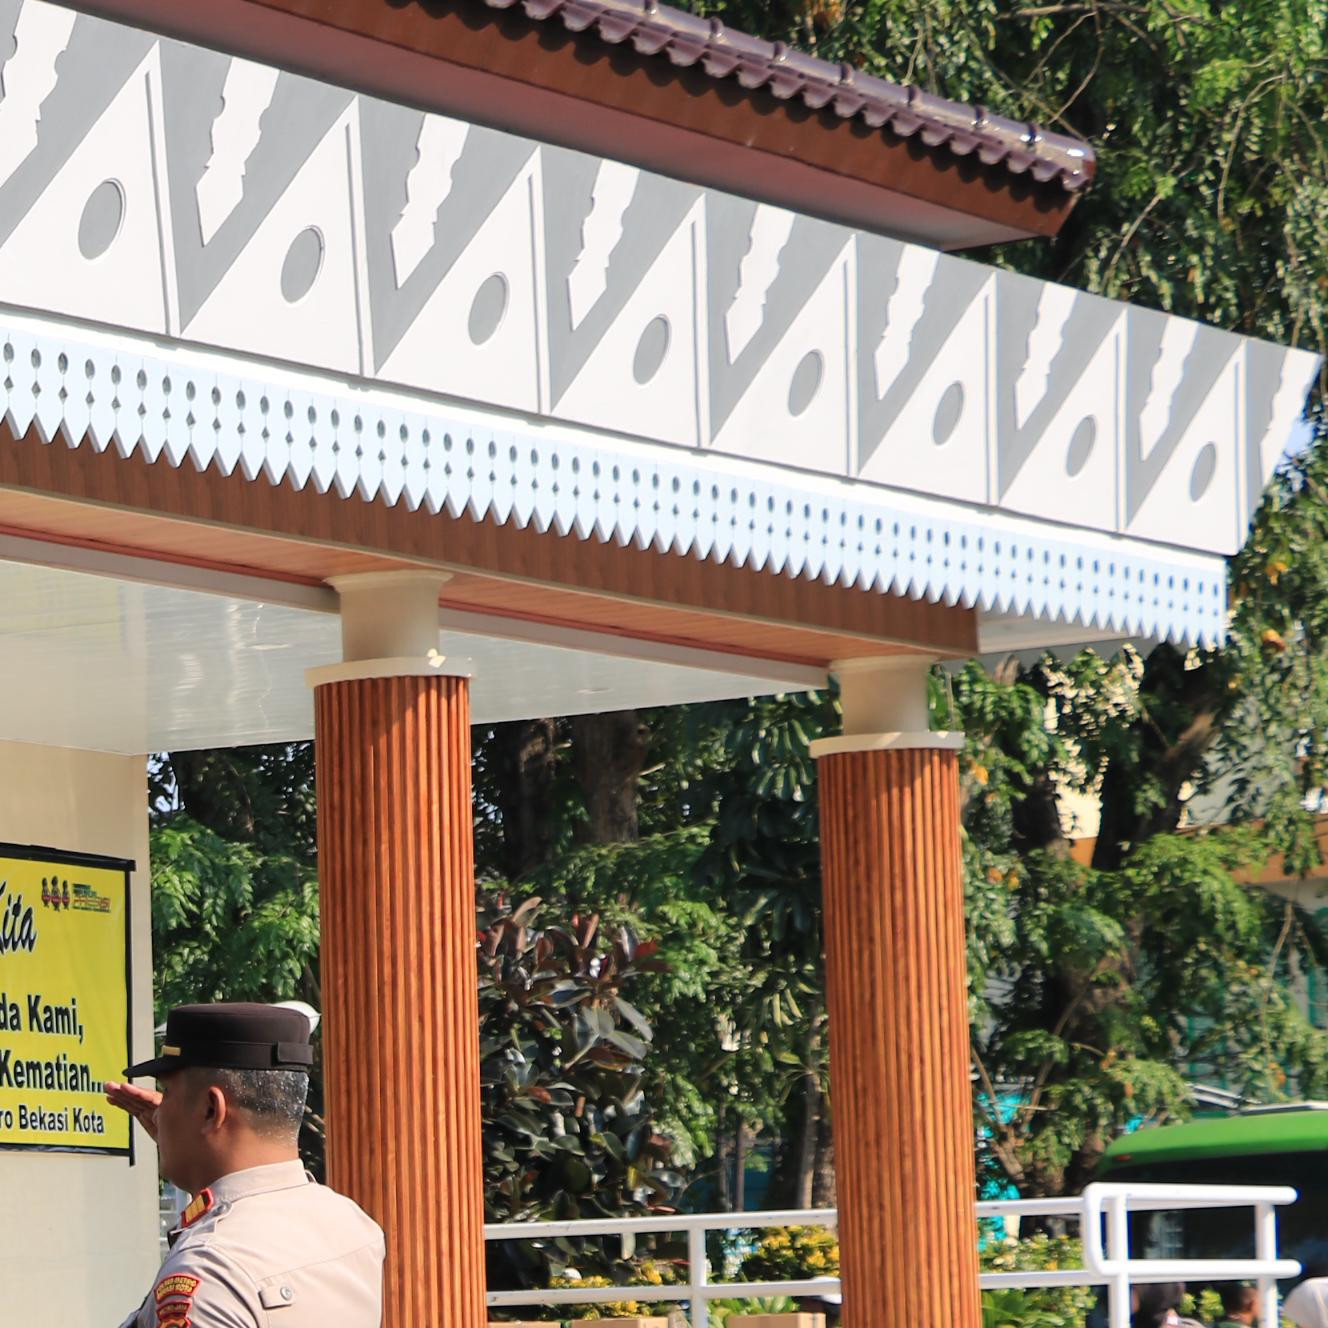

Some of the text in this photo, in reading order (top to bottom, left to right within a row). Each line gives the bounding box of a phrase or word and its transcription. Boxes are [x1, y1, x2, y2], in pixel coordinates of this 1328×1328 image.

[27, 994, 84, 1044] Kami,
[19, 1104, 68, 1132] Bekasi
[73, 1107, 105, 1133] Kota
